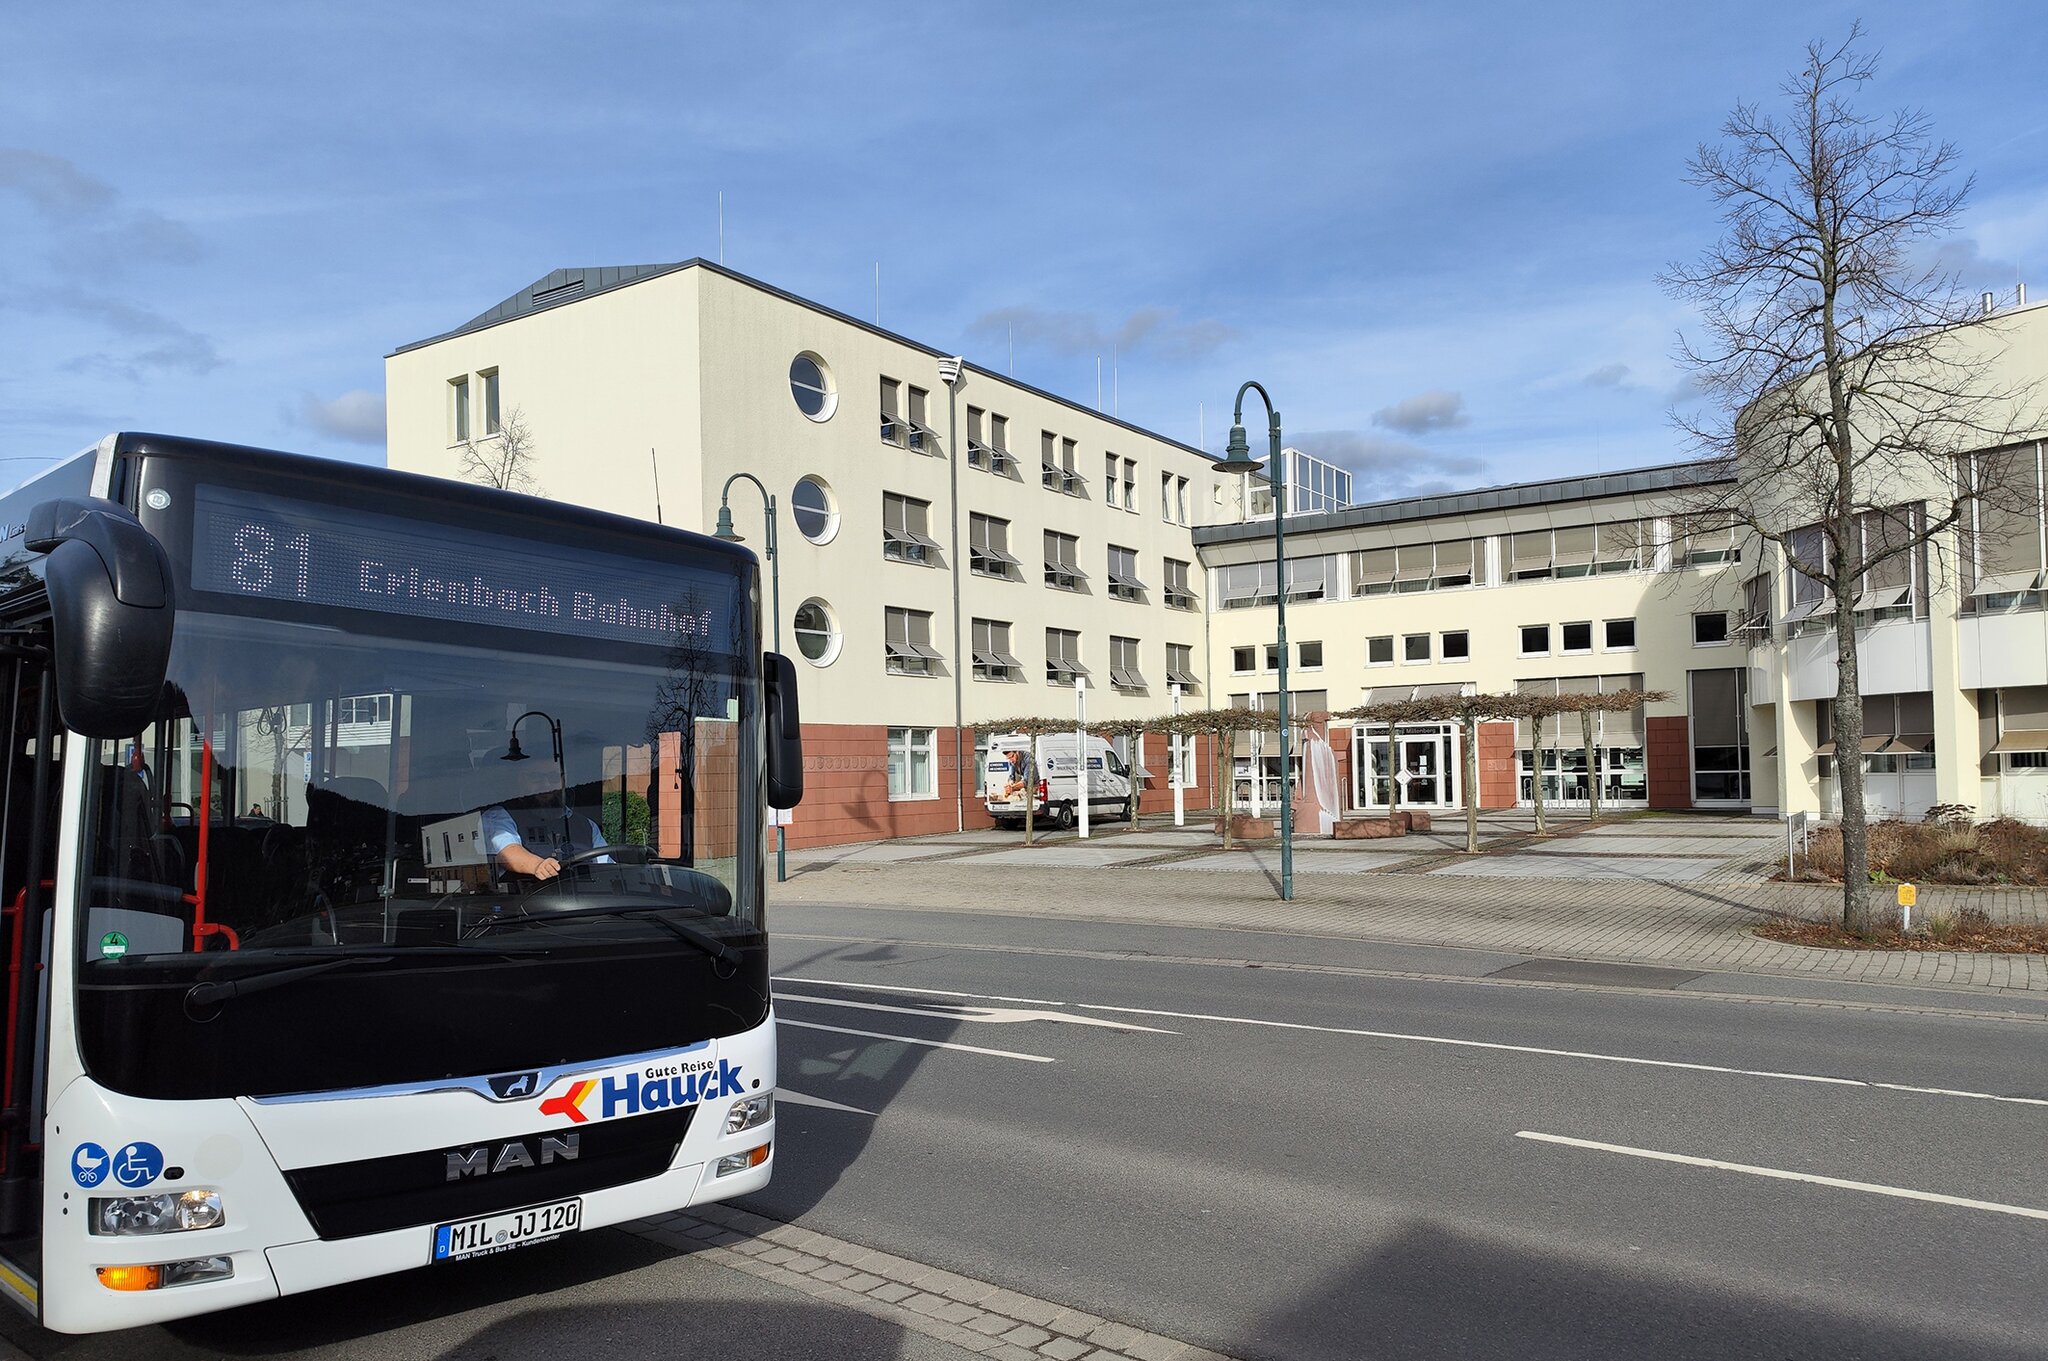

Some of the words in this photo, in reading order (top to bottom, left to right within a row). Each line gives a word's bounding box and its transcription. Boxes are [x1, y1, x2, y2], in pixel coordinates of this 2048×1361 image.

[232, 523, 310, 598] 81
[359, 559, 560, 617] Erlenbach
[572, 590, 713, 637] Bahnhof
[110, 933, 119, 946] 4
[645, 1065, 678, 1079] Gute
[681, 1060, 714, 1074] Reise
[601, 1058, 746, 1119] Hauck
[446, 1133, 580, 1182] MAN
[439, 1245, 446, 1253] D
[451, 1222, 493, 1252] MIL
[455, 1252, 471, 1262] MAN
[472, 1249, 489, 1258] Truck
[495, 1245, 507, 1253] Bus
[522, 1234, 561, 1247] Kundencenter
